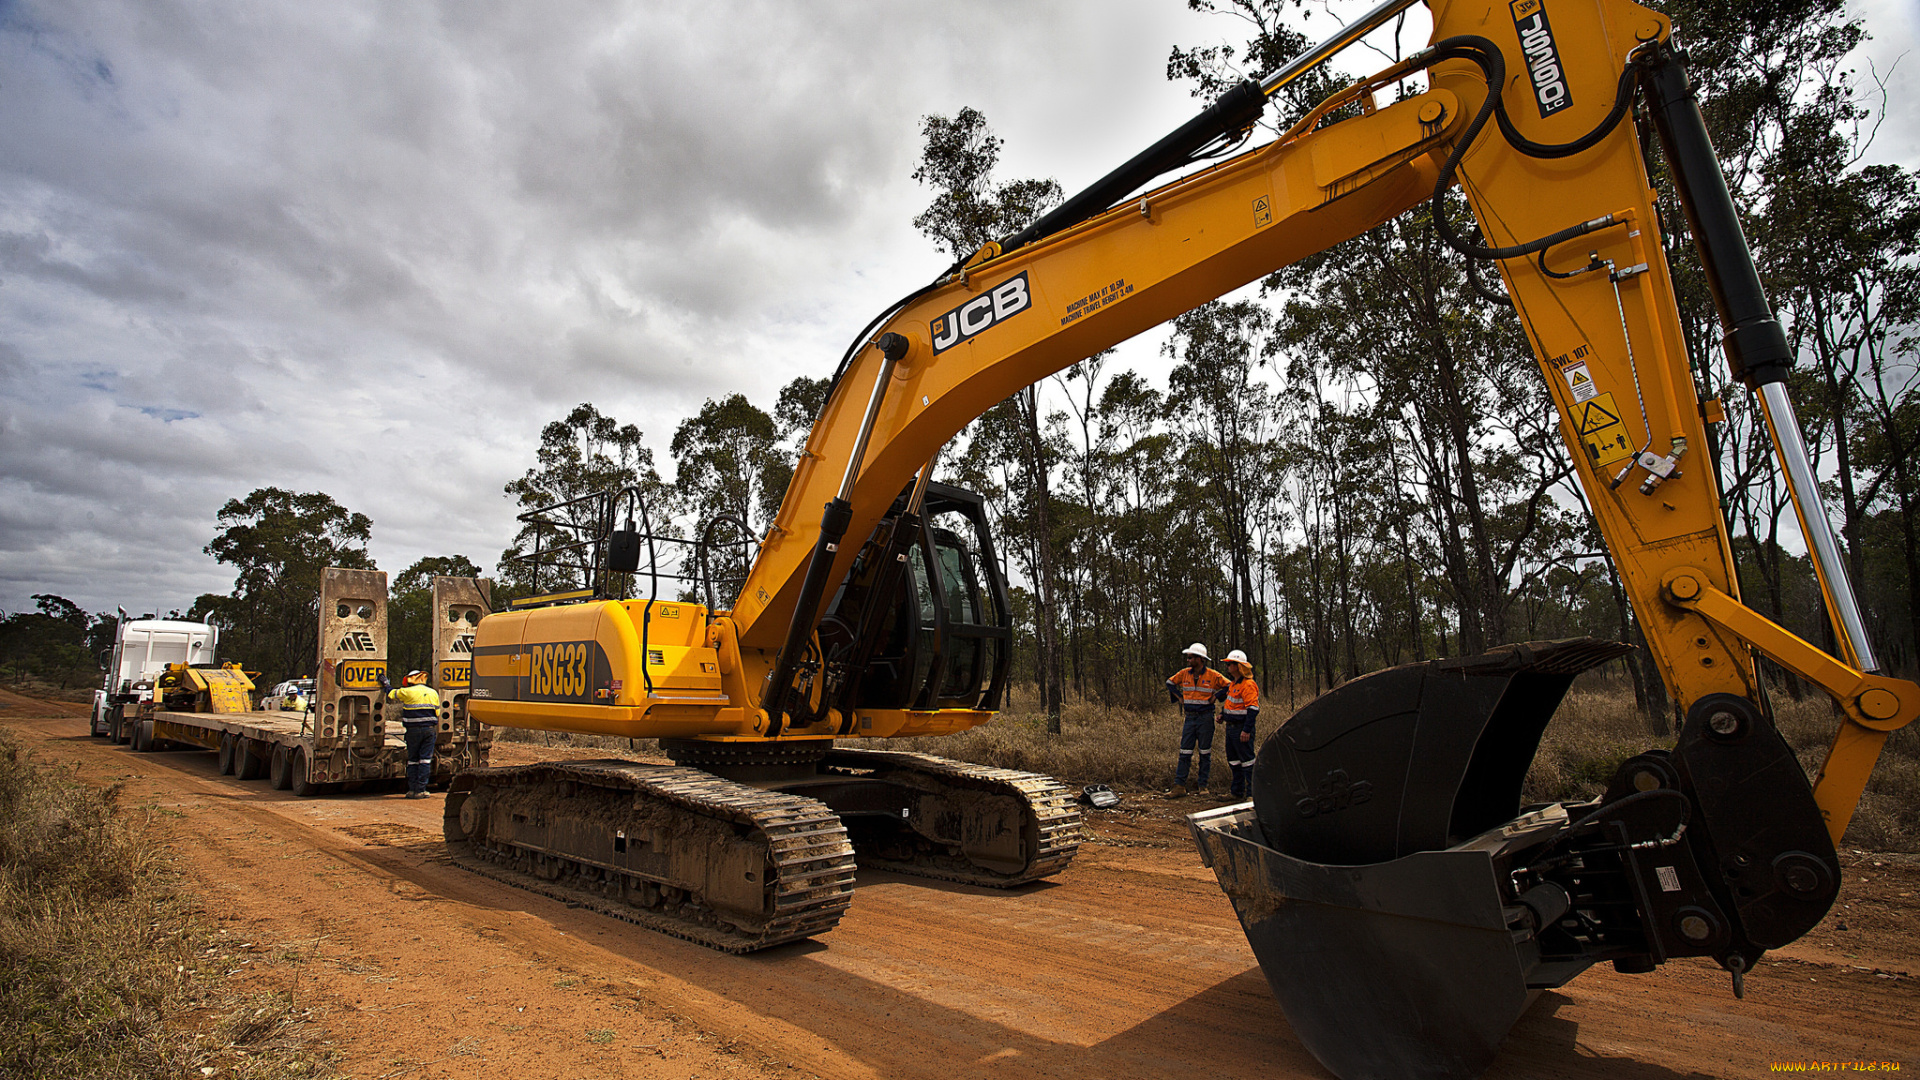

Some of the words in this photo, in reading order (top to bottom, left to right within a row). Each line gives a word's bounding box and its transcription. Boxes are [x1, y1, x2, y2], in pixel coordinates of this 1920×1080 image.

[935, 277, 1028, 350] JCB
[1060, 309, 1083, 326] MACHINE
[1083, 300, 1101, 315] TRAVEL
[1102, 291, 1119, 305] HEIGHT
[1066, 296, 1088, 314] MACHINE
[1089, 290, 1101, 302] MAX
[1551, 354, 1572, 369] SWL
[1573, 345, 1589, 360] 10T
[345, 667, 385, 682] OVER
[530, 643, 587, 697] RSG33
